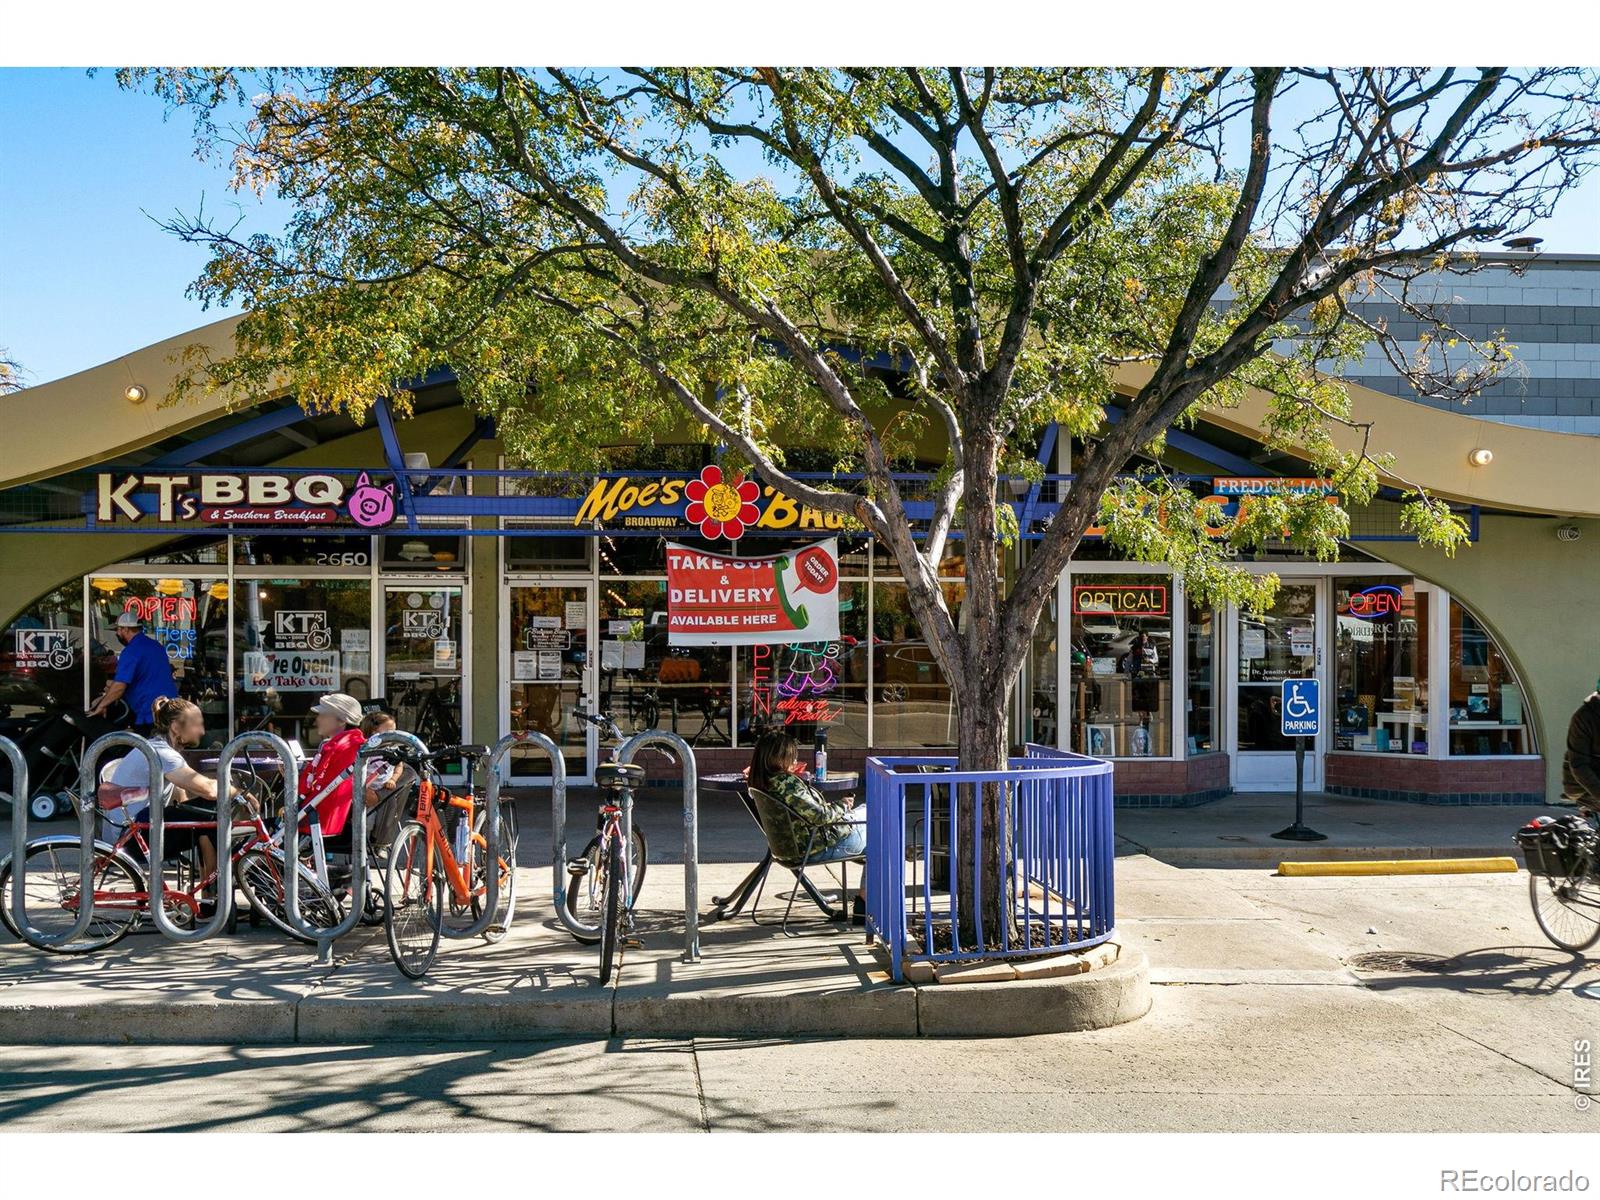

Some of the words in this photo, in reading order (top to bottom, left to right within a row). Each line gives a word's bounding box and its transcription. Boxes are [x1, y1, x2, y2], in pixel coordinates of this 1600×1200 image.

[201, 474, 344, 506] BBQ
[574, 476, 686, 527] Moe's
[210, 510, 220, 519] &
[223, 509, 270, 520] Southern
[274, 509, 326, 522] Breakfast
[624, 516, 678, 527] BROADWAY
[316, 552, 368, 566] 2660
[668, 555, 777, 570] TAKE-OUT
[810, 556, 829, 577] ORDER
[719, 575, 730, 585] &
[670, 587, 776, 604] DELIVERY
[1079, 591, 1161, 609] OPTICAL
[1350, 593, 1401, 612] OPEN
[124, 596, 197, 621] OPEN
[670, 615, 741, 626] AVAILABLE
[742, 614, 777, 625] HERE
[156, 627, 197, 642] Here
[165, 642, 194, 659] Out
[292, 656, 334, 676] Open!
[275, 675, 305, 687] Take
[309, 675, 333, 687] Out
[754, 643, 770, 717] PEN
[1285, 720, 1317, 730] PARKING
